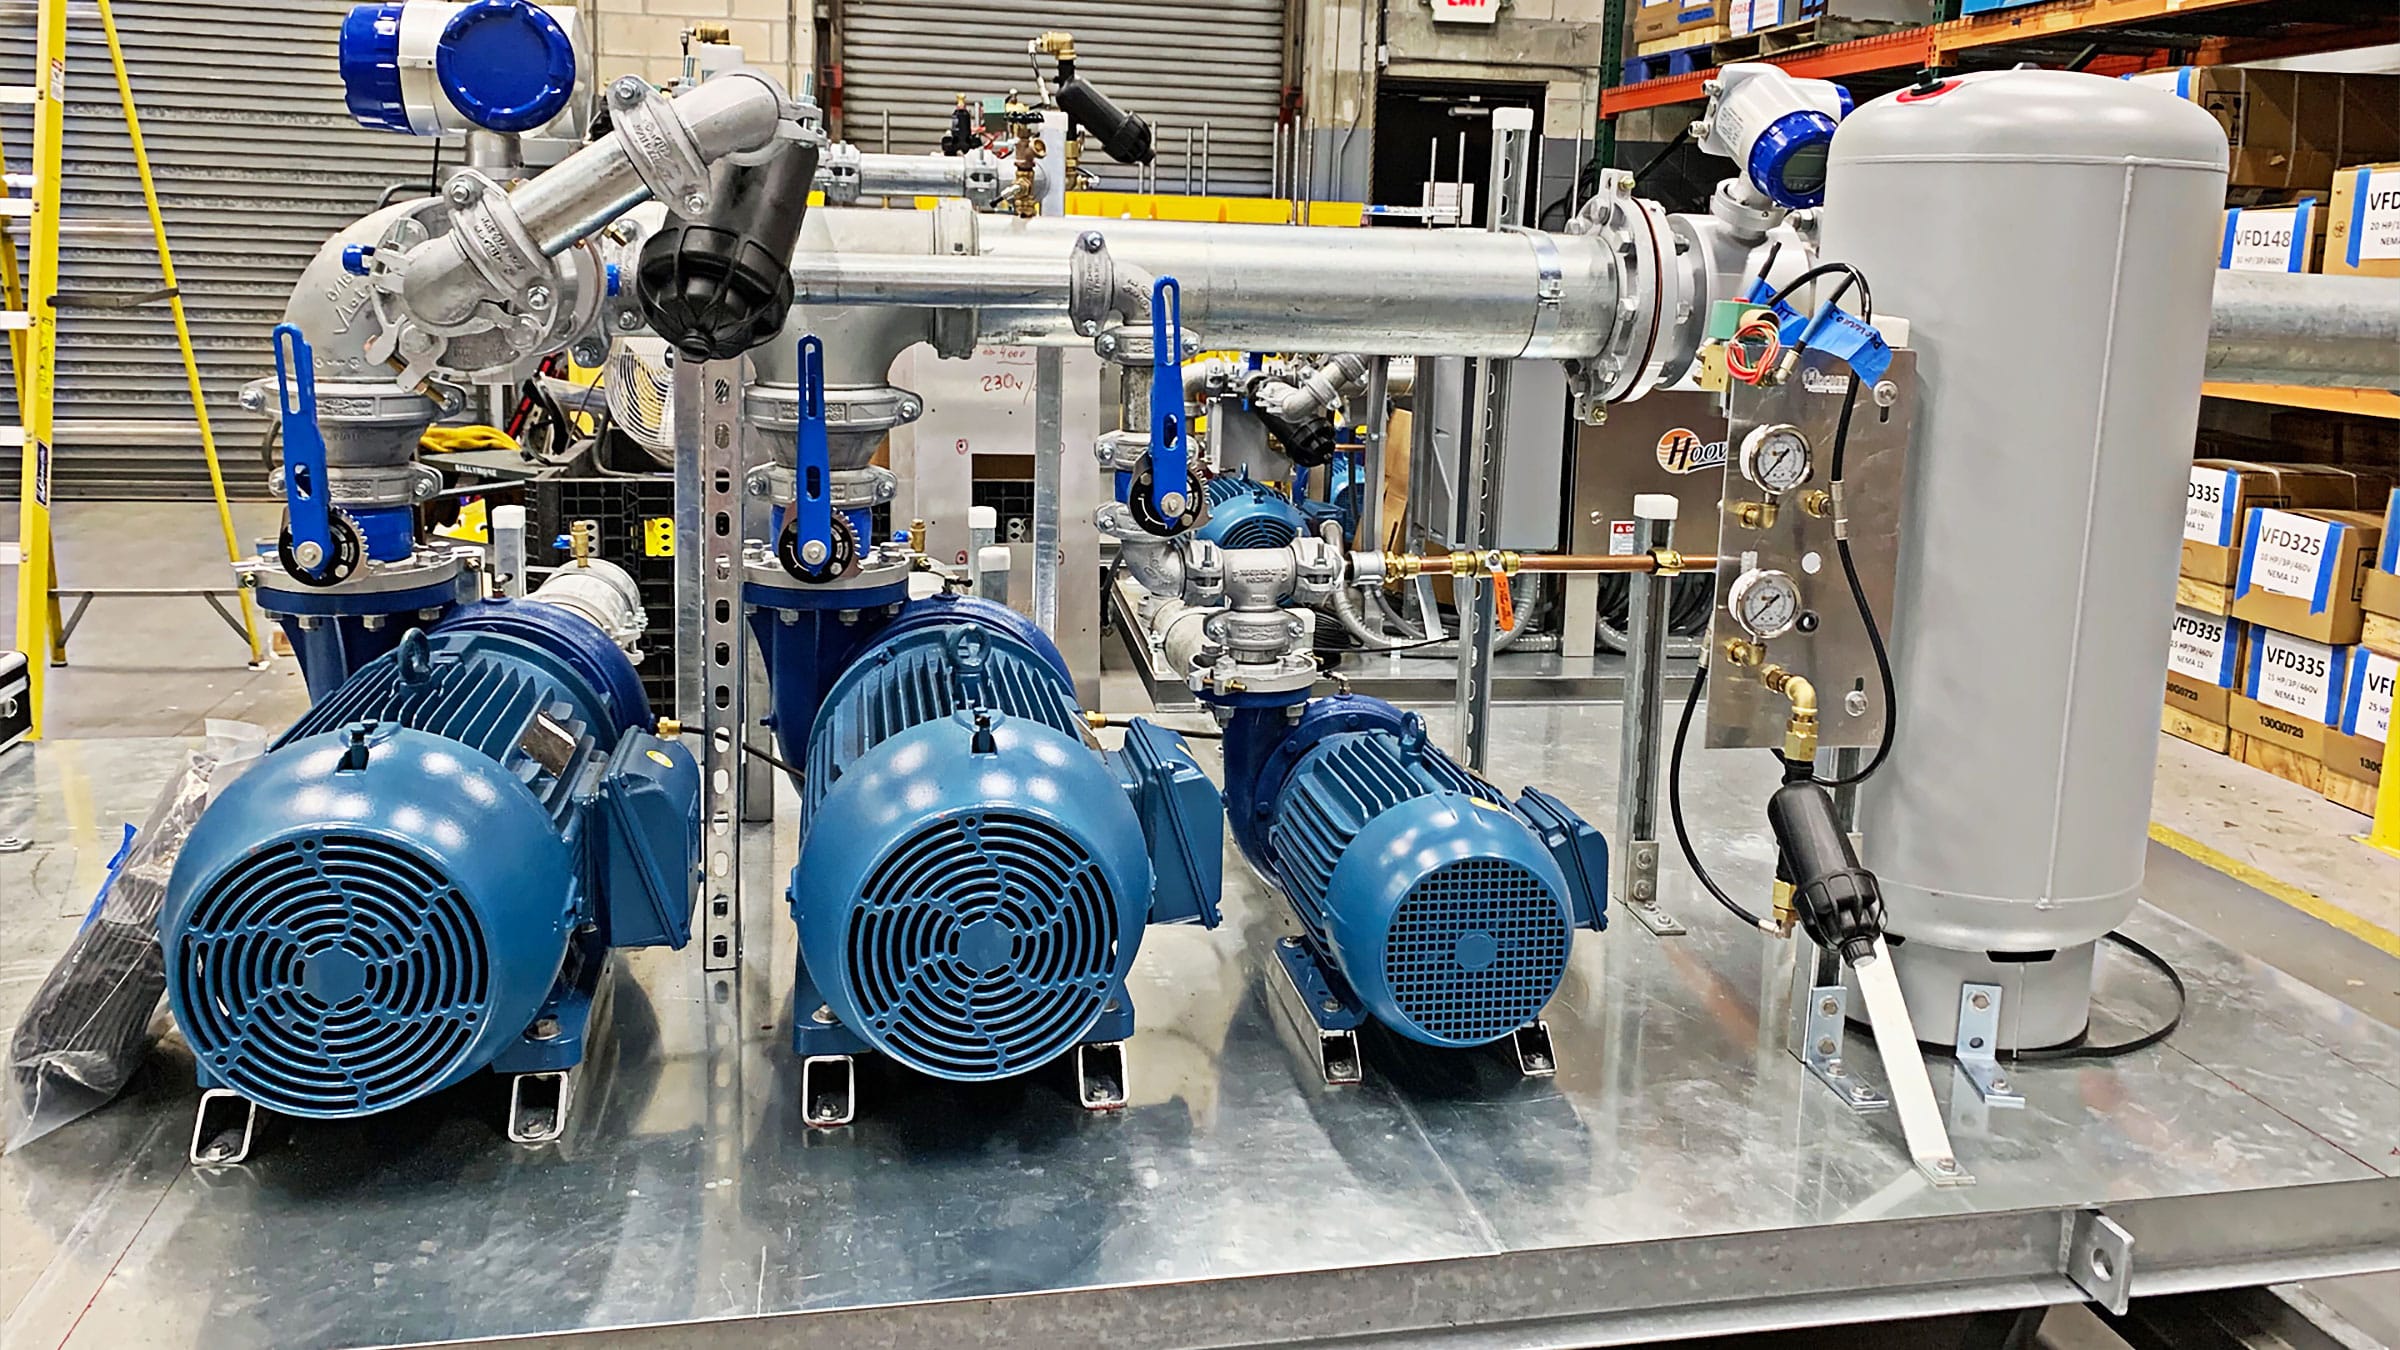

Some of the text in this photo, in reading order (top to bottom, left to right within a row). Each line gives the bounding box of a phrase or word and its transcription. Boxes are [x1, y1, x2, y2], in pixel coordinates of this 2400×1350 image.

[2235, 230, 2291, 248] VFD148
[2261, 526, 2321, 556] VFD325
[2267, 569, 2299, 584] NEMA 12
[2267, 645, 2326, 678] VFD335
[2274, 689, 2306, 706] NEMA 12
